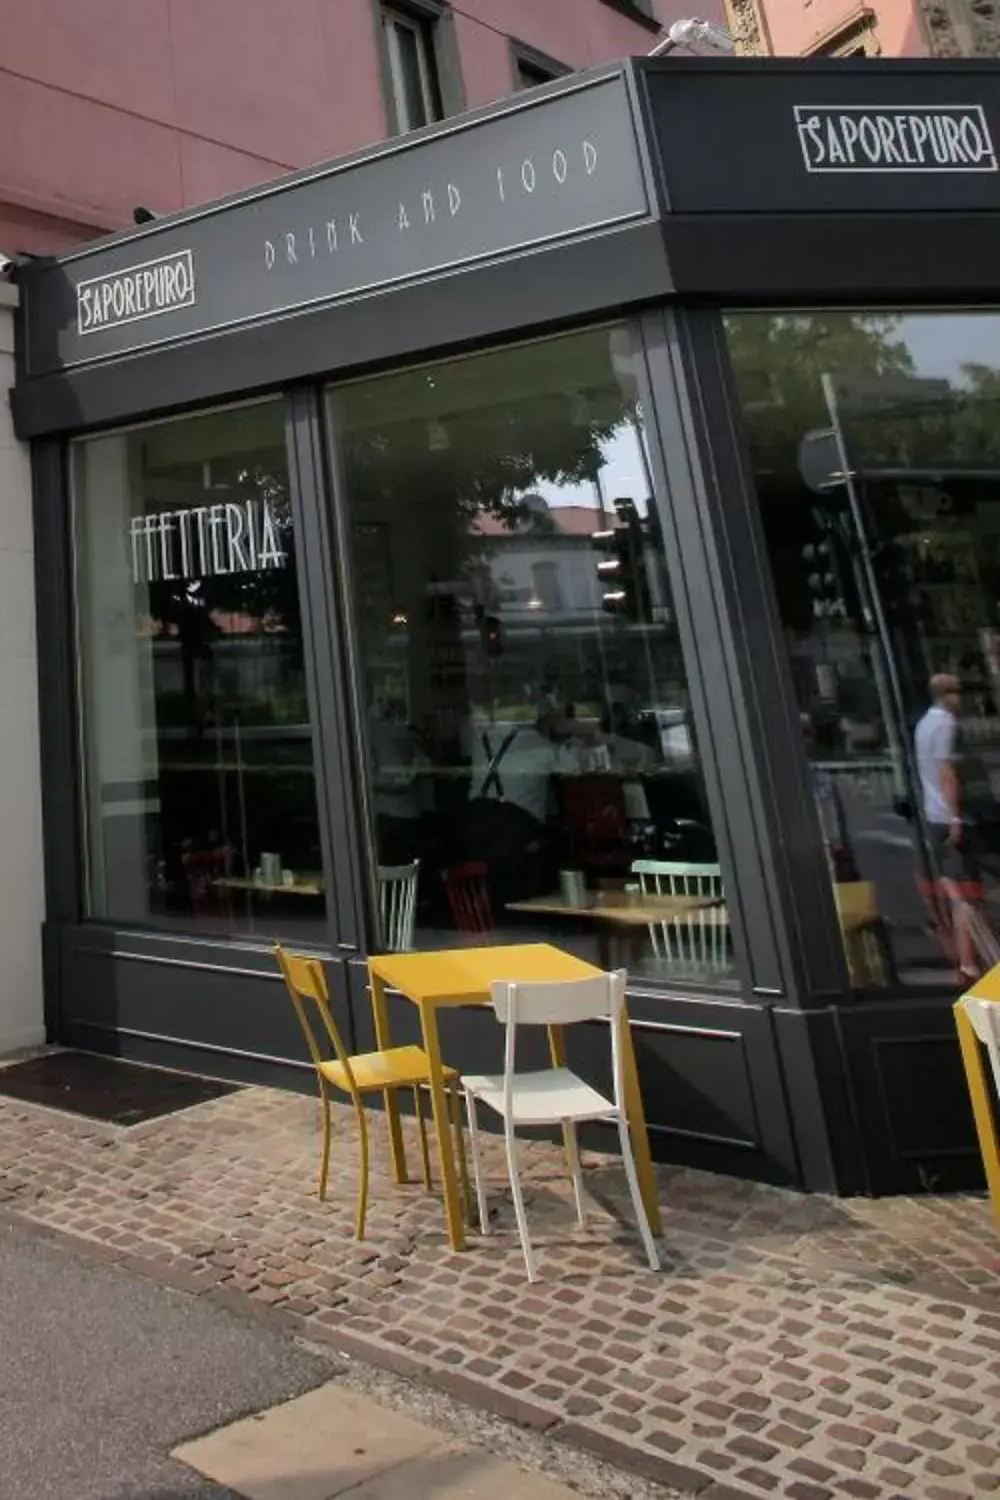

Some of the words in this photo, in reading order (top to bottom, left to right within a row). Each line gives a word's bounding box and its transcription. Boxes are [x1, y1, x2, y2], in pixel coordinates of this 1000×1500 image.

[799, 114, 991, 164] SAPOREPURO
[264, 213, 364, 270] DRINK
[397, 183, 461, 231] AND
[81, 260, 192, 327] SAPOREPURO
